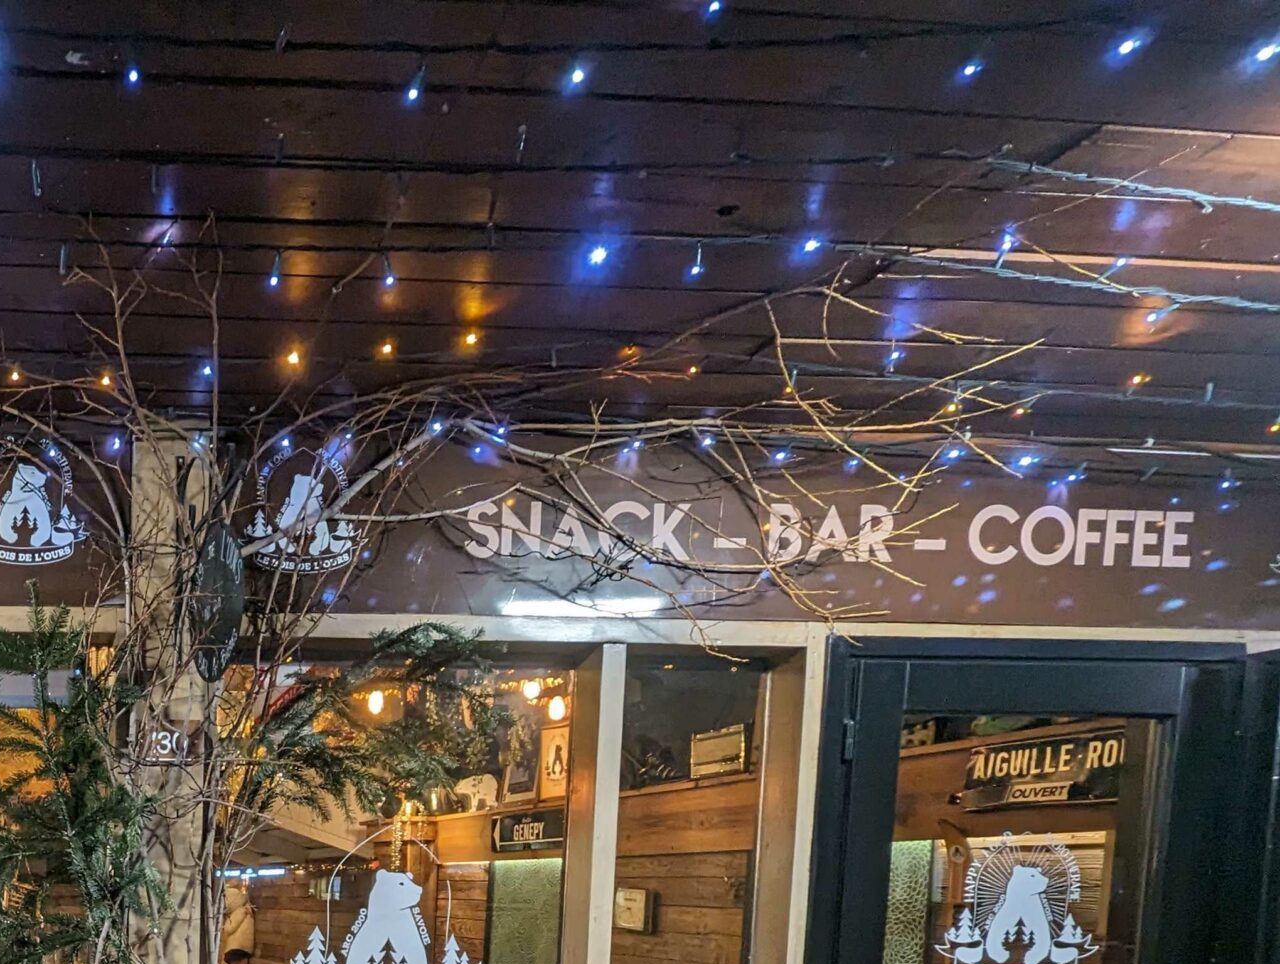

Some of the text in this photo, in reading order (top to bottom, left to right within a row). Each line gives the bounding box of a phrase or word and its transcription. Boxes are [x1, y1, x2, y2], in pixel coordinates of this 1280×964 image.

[464, 500, 693, 561] SNACK
[766, 503, 893, 563] BAR
[968, 503, 1195, 567] COFFEE
[18, 551, 32, 561] DE
[34, 545, 71, 561] L'OURS
[257, 554, 268, 563] LE
[973, 744, 1074, 779] AIGUILLE
[1012, 786, 1066, 799] OUVERT
[963, 858, 982, 902] HAPPY
[341, 908, 368, 956] ARC 2000
[412, 906, 432, 946] SAVOIE
